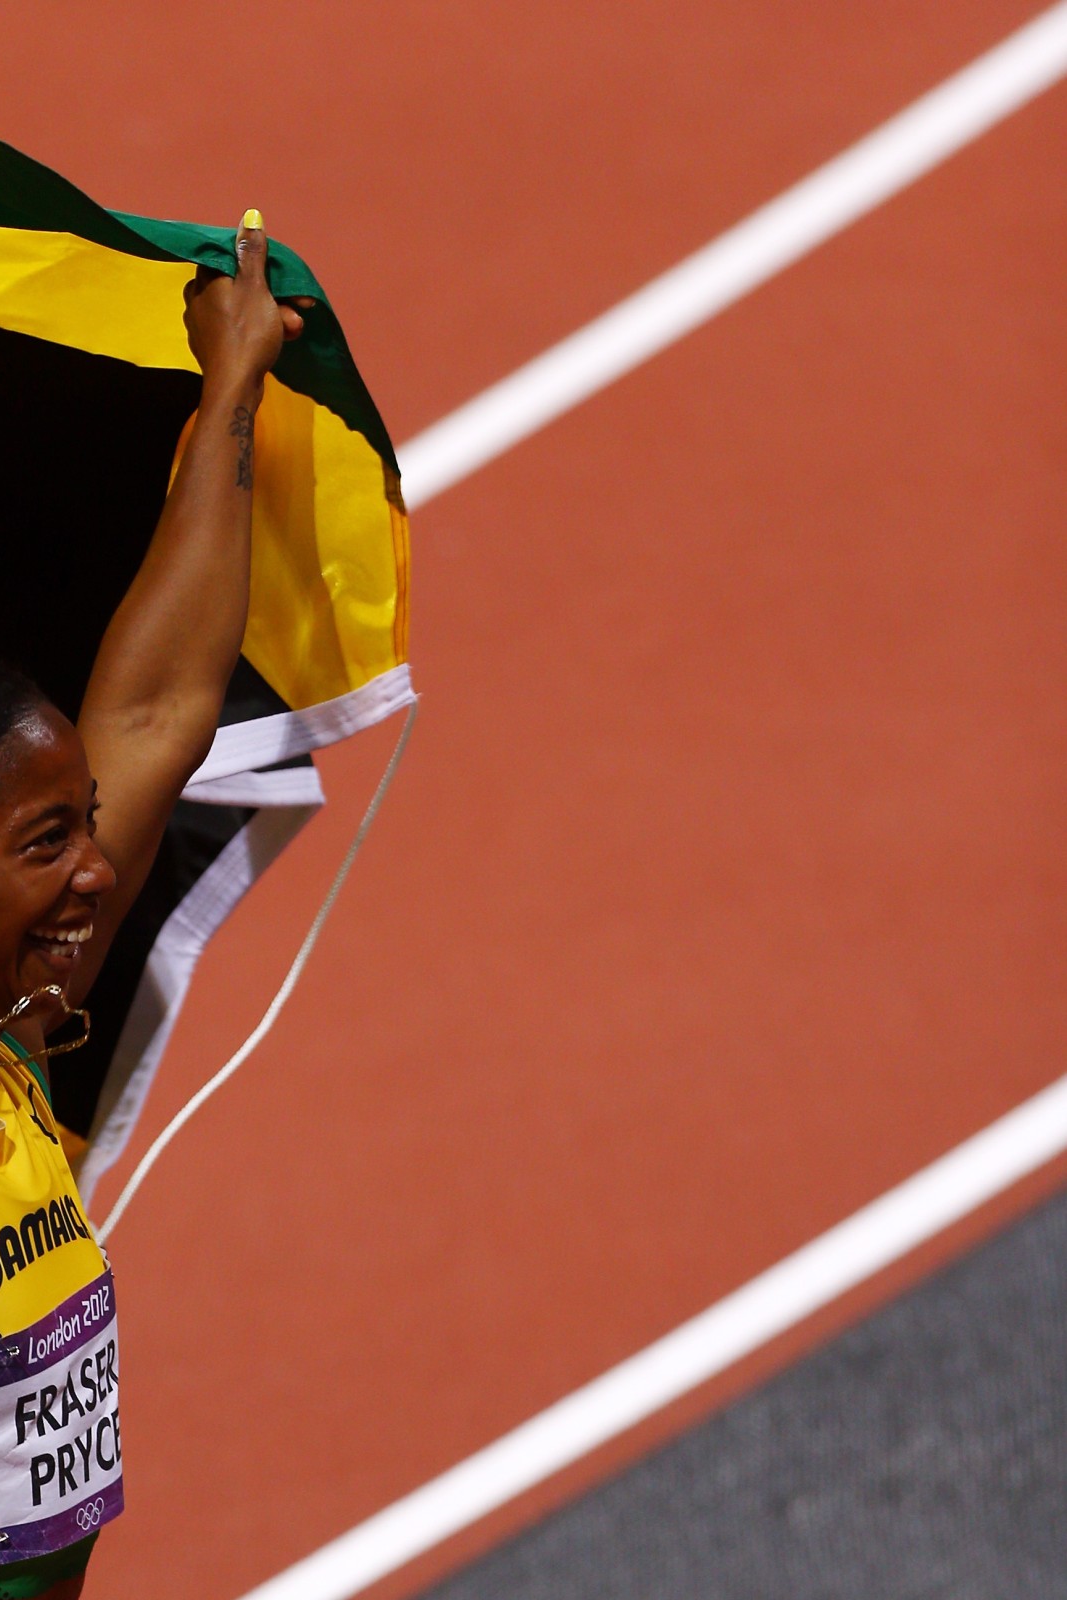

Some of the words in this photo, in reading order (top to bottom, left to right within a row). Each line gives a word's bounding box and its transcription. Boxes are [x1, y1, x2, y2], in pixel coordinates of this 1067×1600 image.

[28, 1314, 81, 1364] London
[81, 1286, 110, 1326] 2012
[15, 1339, 119, 1445] FRASER
